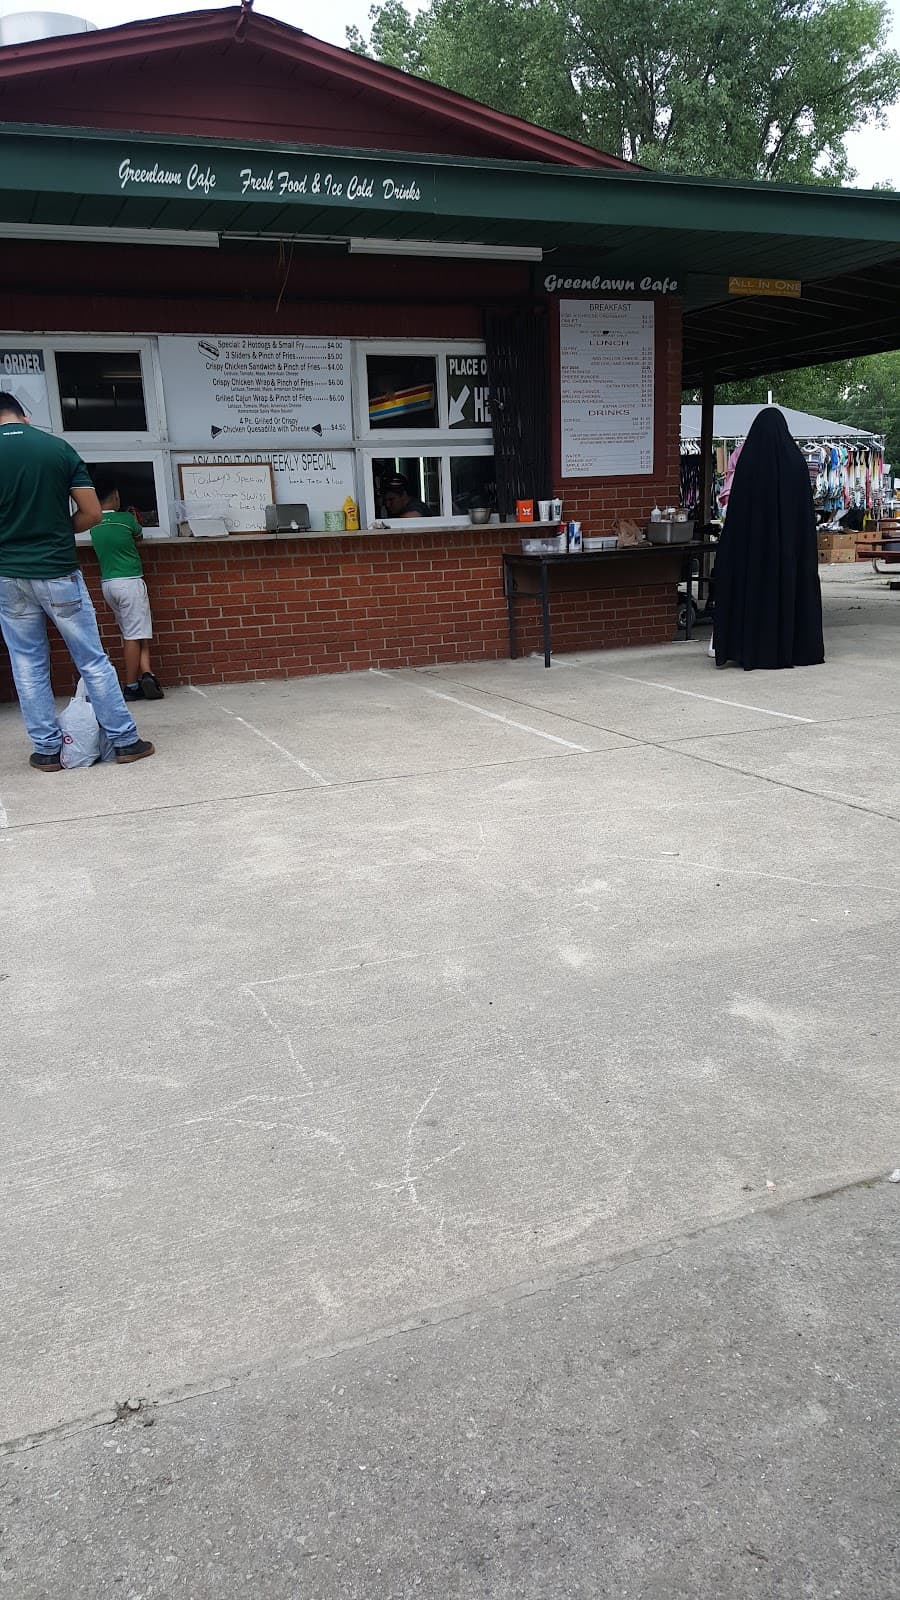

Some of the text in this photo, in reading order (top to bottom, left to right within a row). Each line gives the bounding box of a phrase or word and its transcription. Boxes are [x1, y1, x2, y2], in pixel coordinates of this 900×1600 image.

[118, 158, 217, 194] Greenlawn Cafe
[239, 168, 421, 200] Fresh Food & Ice Cold Drinks
[544, 274, 678, 294] Greenlawn Cafe
[589, 303, 632, 311] BREAKFAST
[4, 354, 40, 373] ORDER
[449, 358, 479, 375] PLACE
[301, 453, 337, 471] SPECIAL
